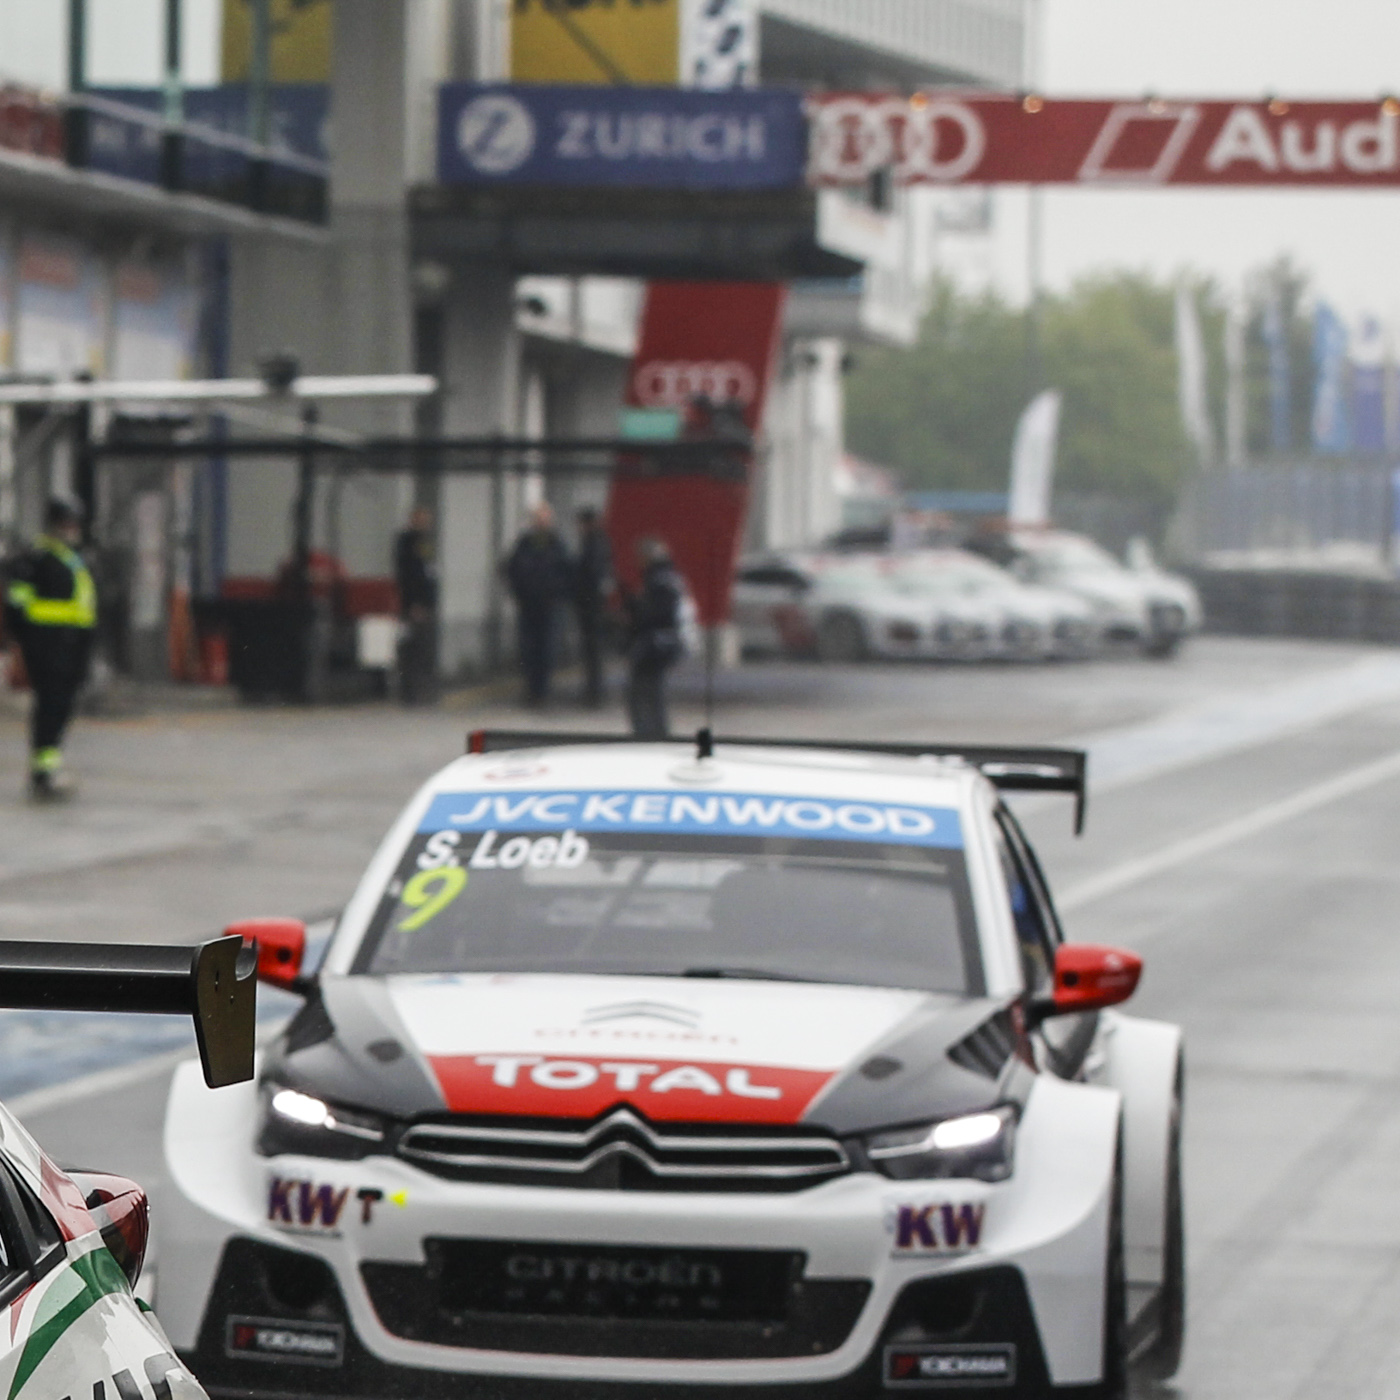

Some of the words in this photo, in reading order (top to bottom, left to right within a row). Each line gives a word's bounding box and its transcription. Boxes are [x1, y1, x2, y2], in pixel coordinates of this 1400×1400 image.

[554, 109, 766, 159] ZURICH
[1204, 103, 1400, 173] Aud
[416, 829, 462, 869] S.
[468, 828, 590, 869] Loeb
[397, 865, 469, 932] 9
[475, 1055, 783, 1100] TOTAL
[267, 1175, 349, 1227] KW
[895, 1202, 986, 1249] KW
